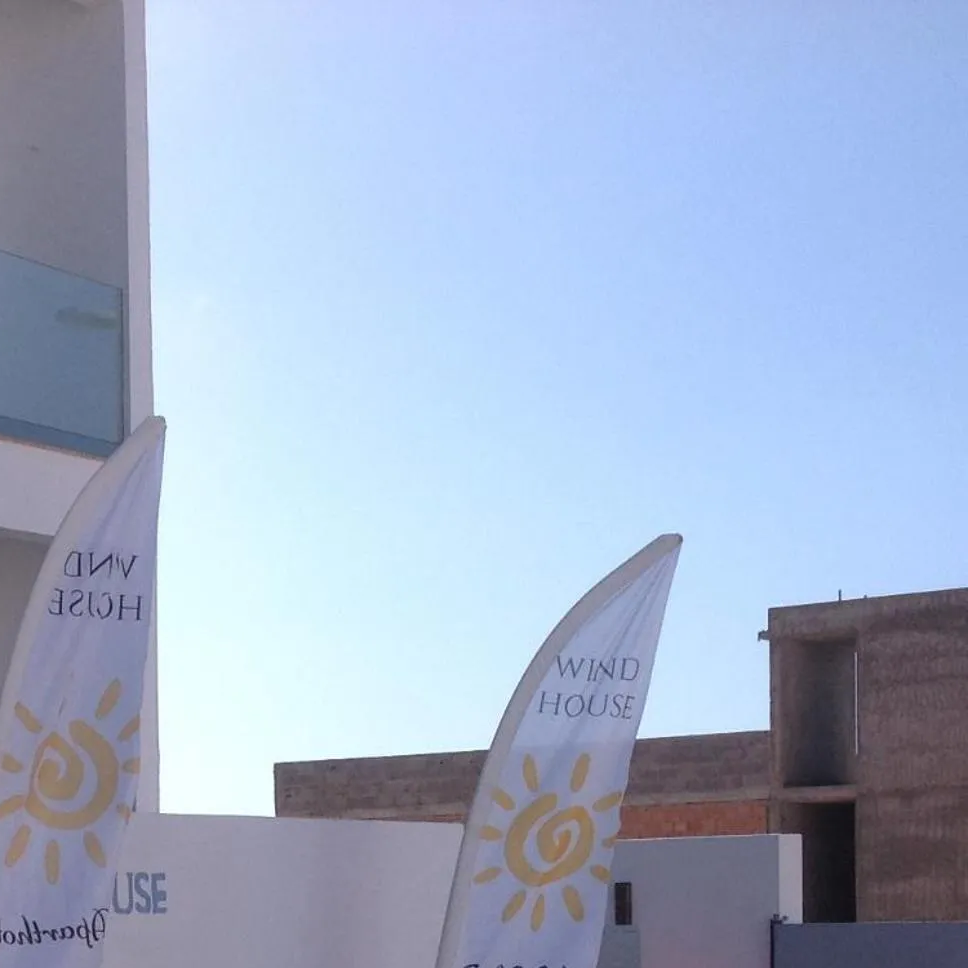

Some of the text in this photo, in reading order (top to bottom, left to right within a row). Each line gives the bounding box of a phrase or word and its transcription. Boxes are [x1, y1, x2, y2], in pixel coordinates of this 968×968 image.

[555, 655, 640, 682] WIND
[538, 690, 635, 720] HOUSE
[112, 871, 168, 914] USE
